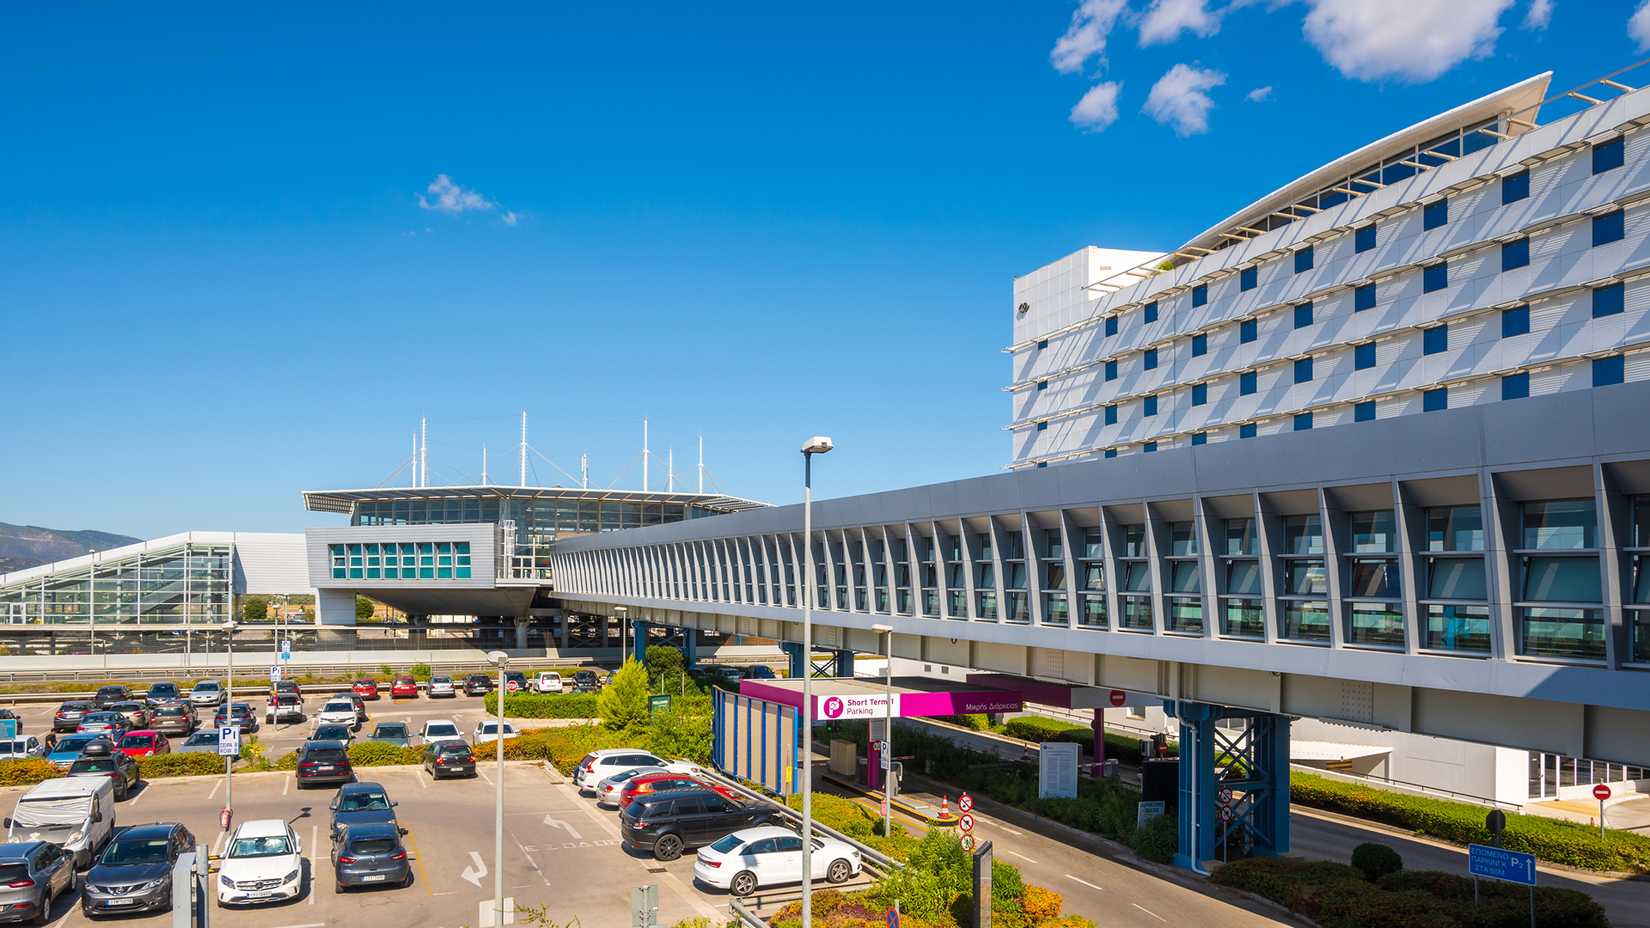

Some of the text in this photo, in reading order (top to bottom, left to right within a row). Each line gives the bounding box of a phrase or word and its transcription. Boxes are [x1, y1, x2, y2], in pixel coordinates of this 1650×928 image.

[847, 698, 868, 707] Short
[870, 698, 889, 706] Term
[846, 707, 874, 716] Parking
